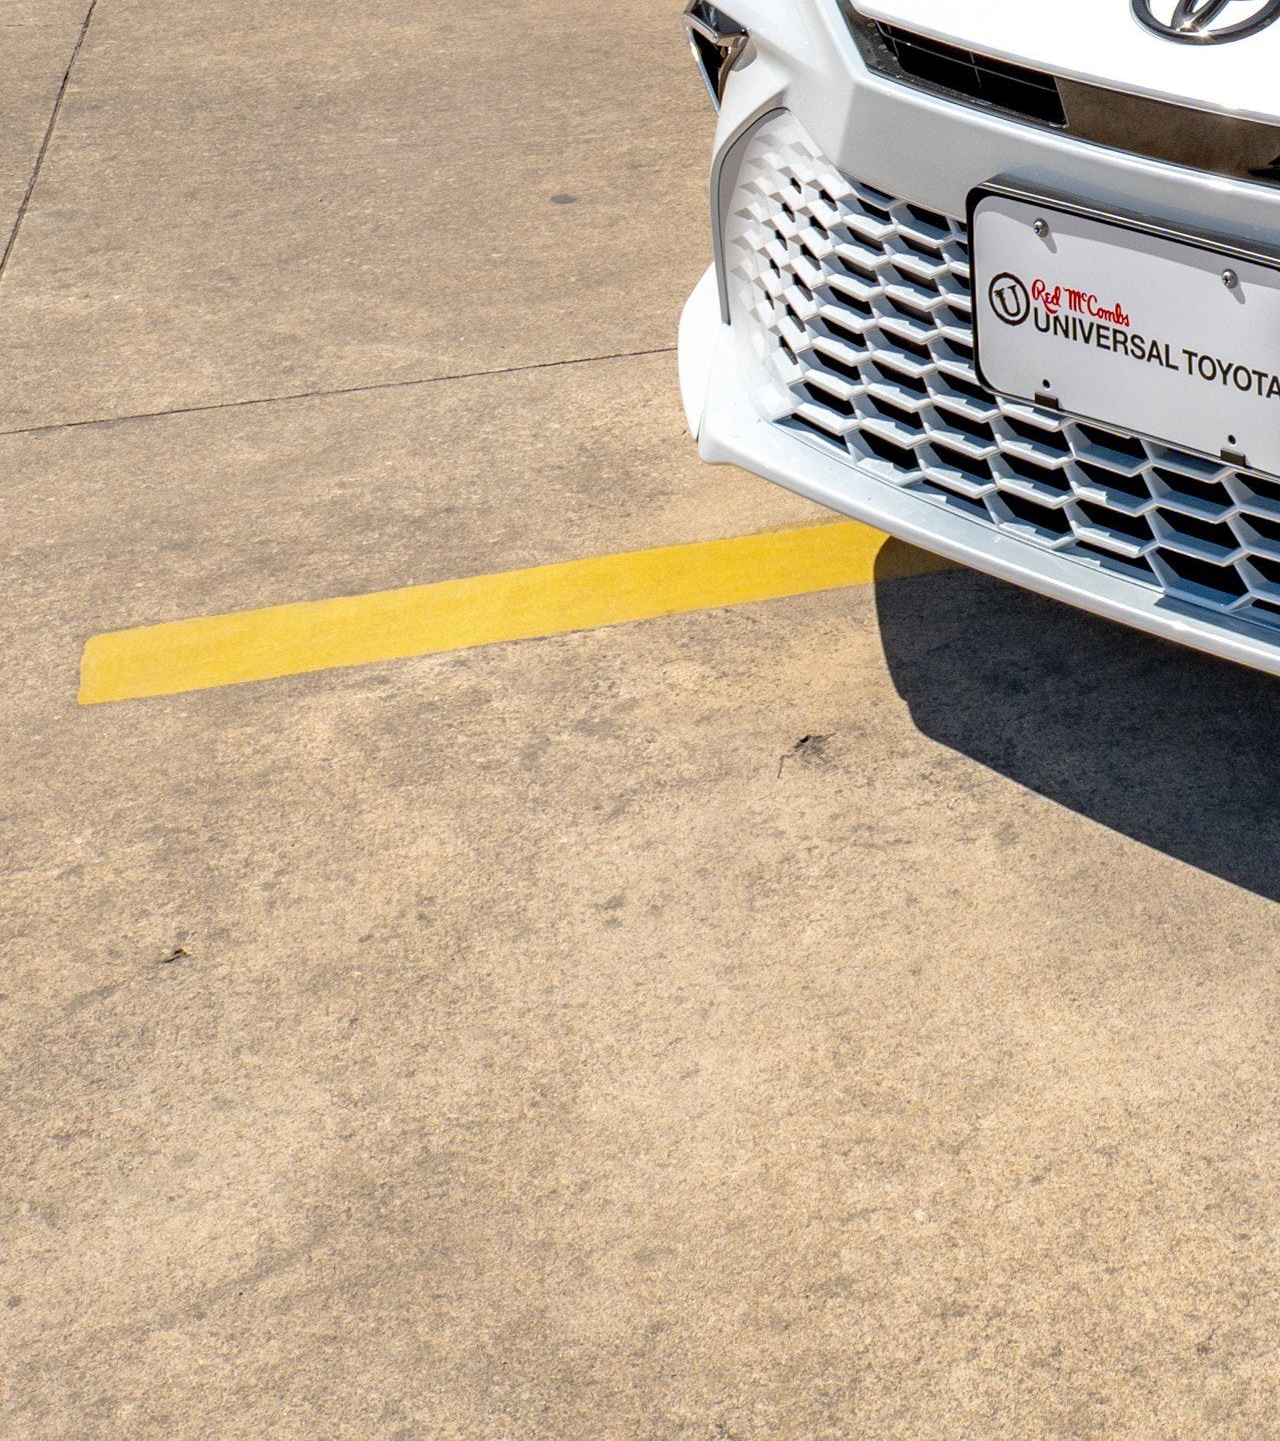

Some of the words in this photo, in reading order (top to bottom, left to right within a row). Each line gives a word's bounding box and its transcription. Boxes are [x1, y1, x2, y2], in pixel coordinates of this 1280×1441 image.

[1031, 278, 1062, 314] Red
[1062, 286, 1131, 328] McCombs
[1033, 306, 1180, 372] UNIVERSAL
